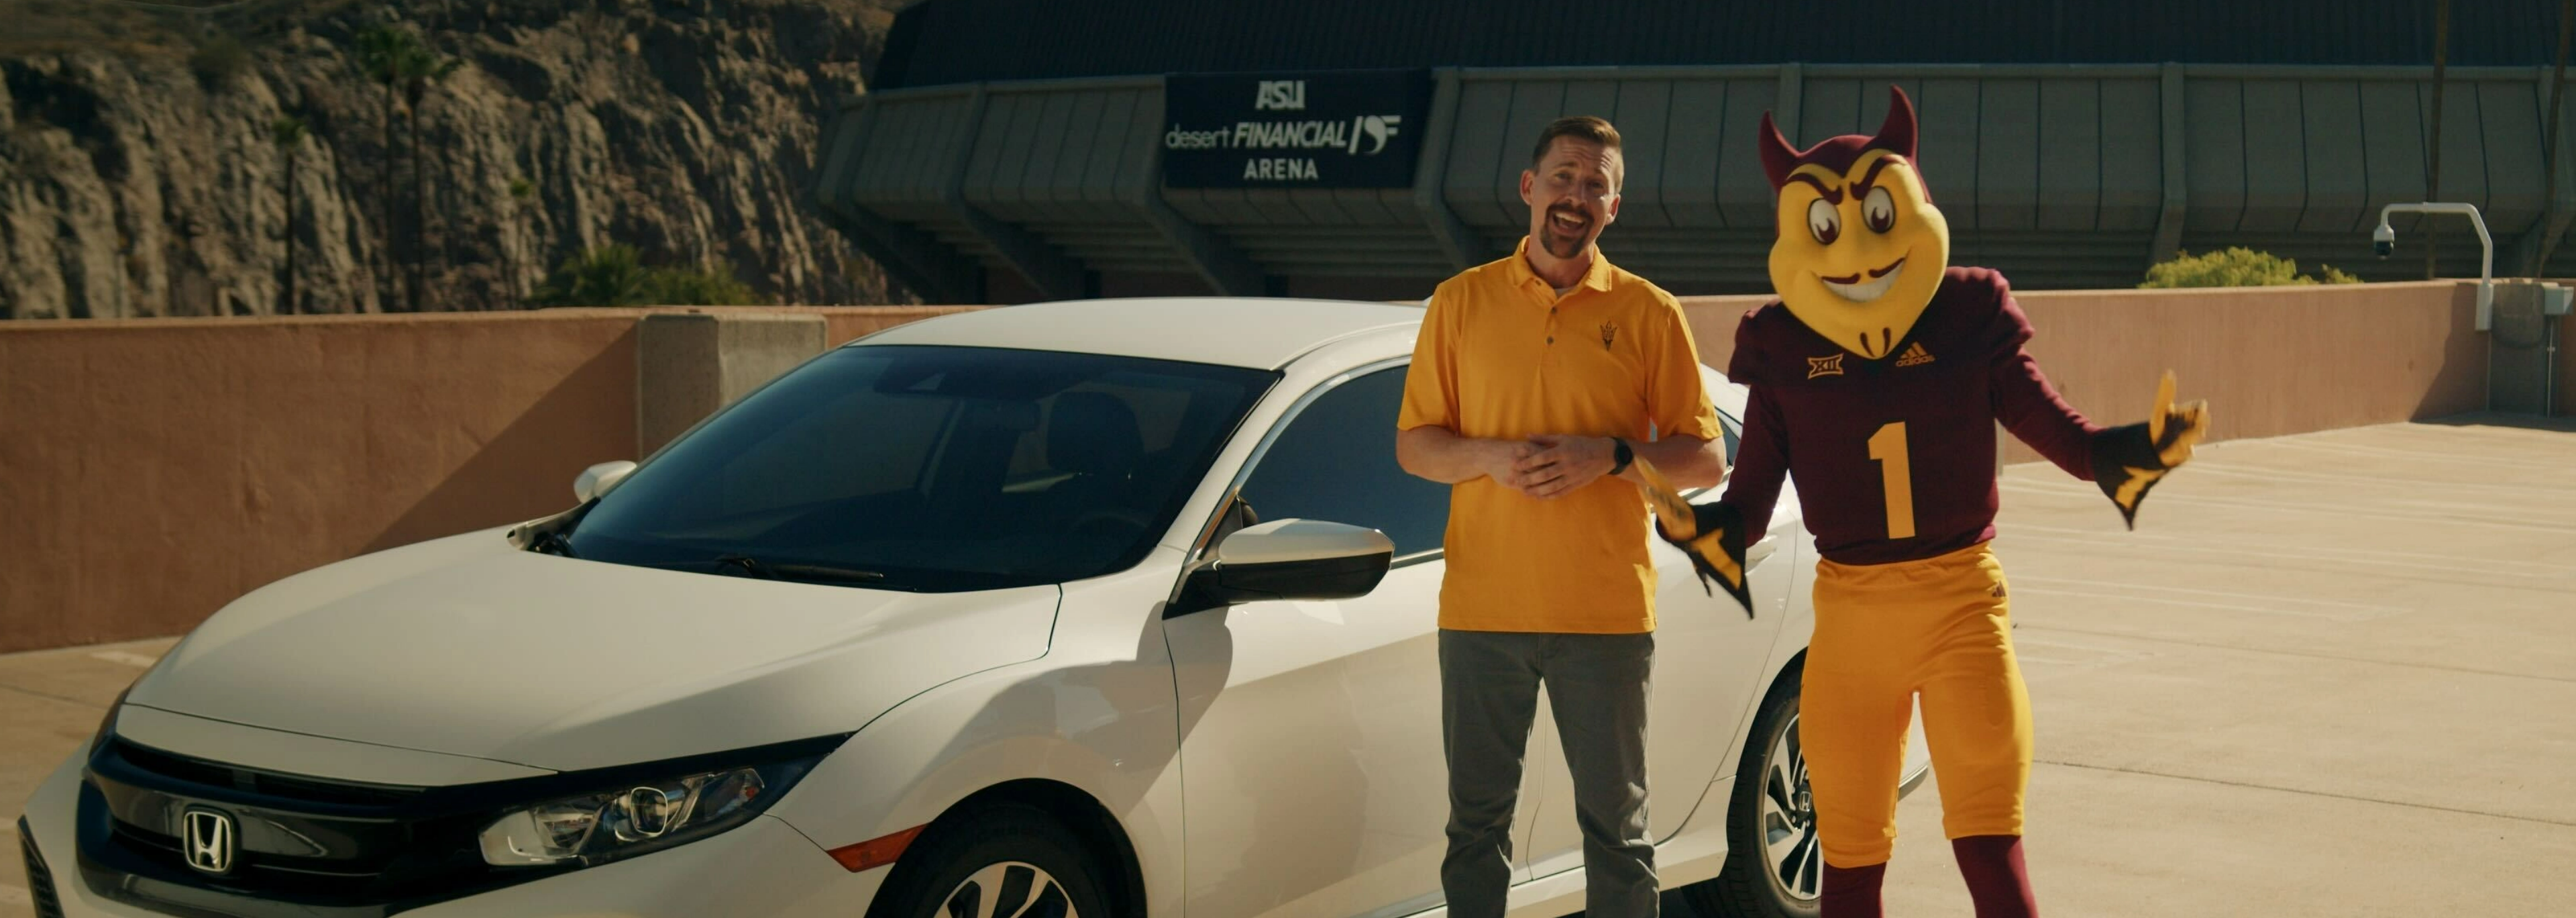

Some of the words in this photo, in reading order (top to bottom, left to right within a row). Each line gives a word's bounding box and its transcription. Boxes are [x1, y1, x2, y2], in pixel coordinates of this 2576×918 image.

[1255, 80, 1305, 110] ASU
[1165, 123, 1230, 149] desert
[1232, 121, 1347, 148] FINANCIAL
[1243, 158, 1319, 180] ARENA
[1895, 354, 1935, 367] adidas
[1868, 421, 1915, 540] 1
